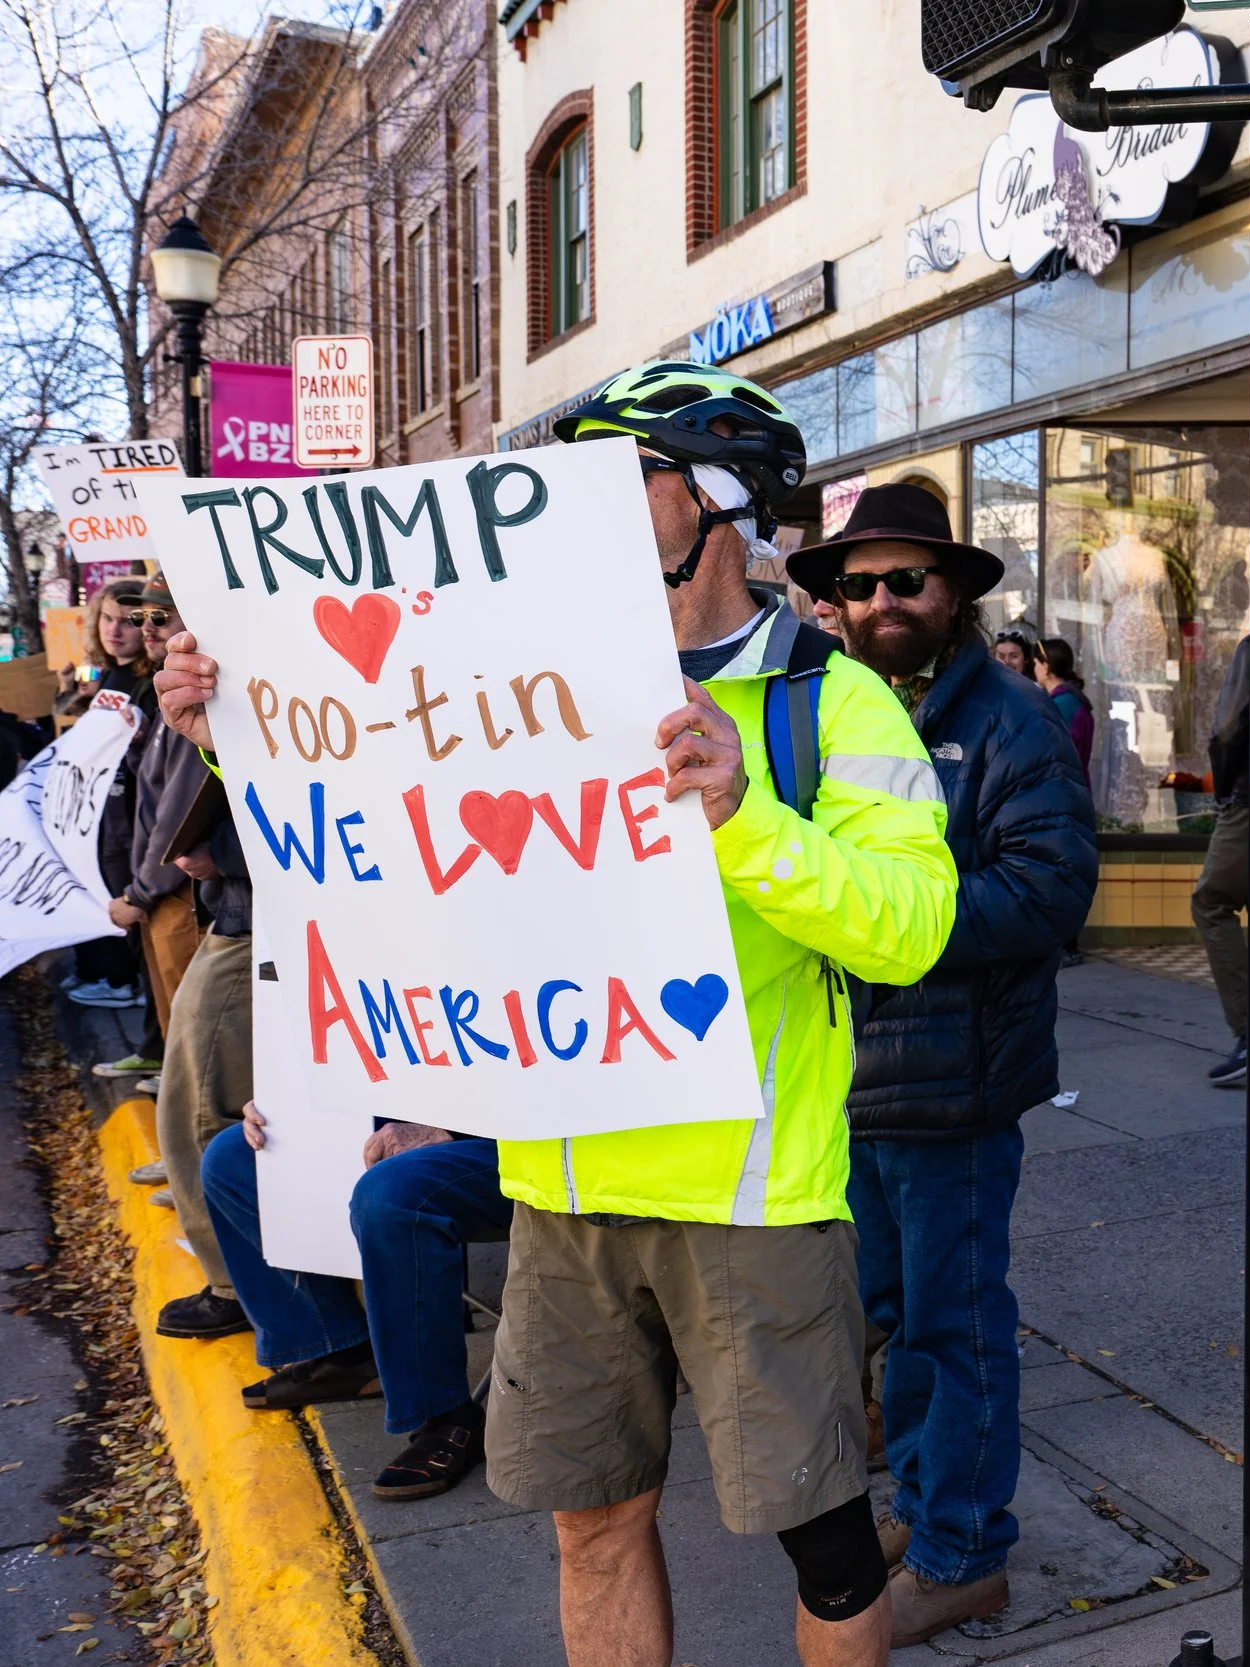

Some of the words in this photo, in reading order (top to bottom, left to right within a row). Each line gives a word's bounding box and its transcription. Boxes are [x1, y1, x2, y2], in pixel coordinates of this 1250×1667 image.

[318, 347, 347, 370] NO
[300, 374, 367, 398] PARKING
[304, 405, 340, 421] HERE
[346, 405, 363, 420] TO
[306, 424, 362, 440] CORNER
[89, 445, 175, 469] TIRED
[785, 471, 797, 481] BELL
[181, 461, 548, 595] TRUMP
[307, 920, 677, 1083] AMERICA
